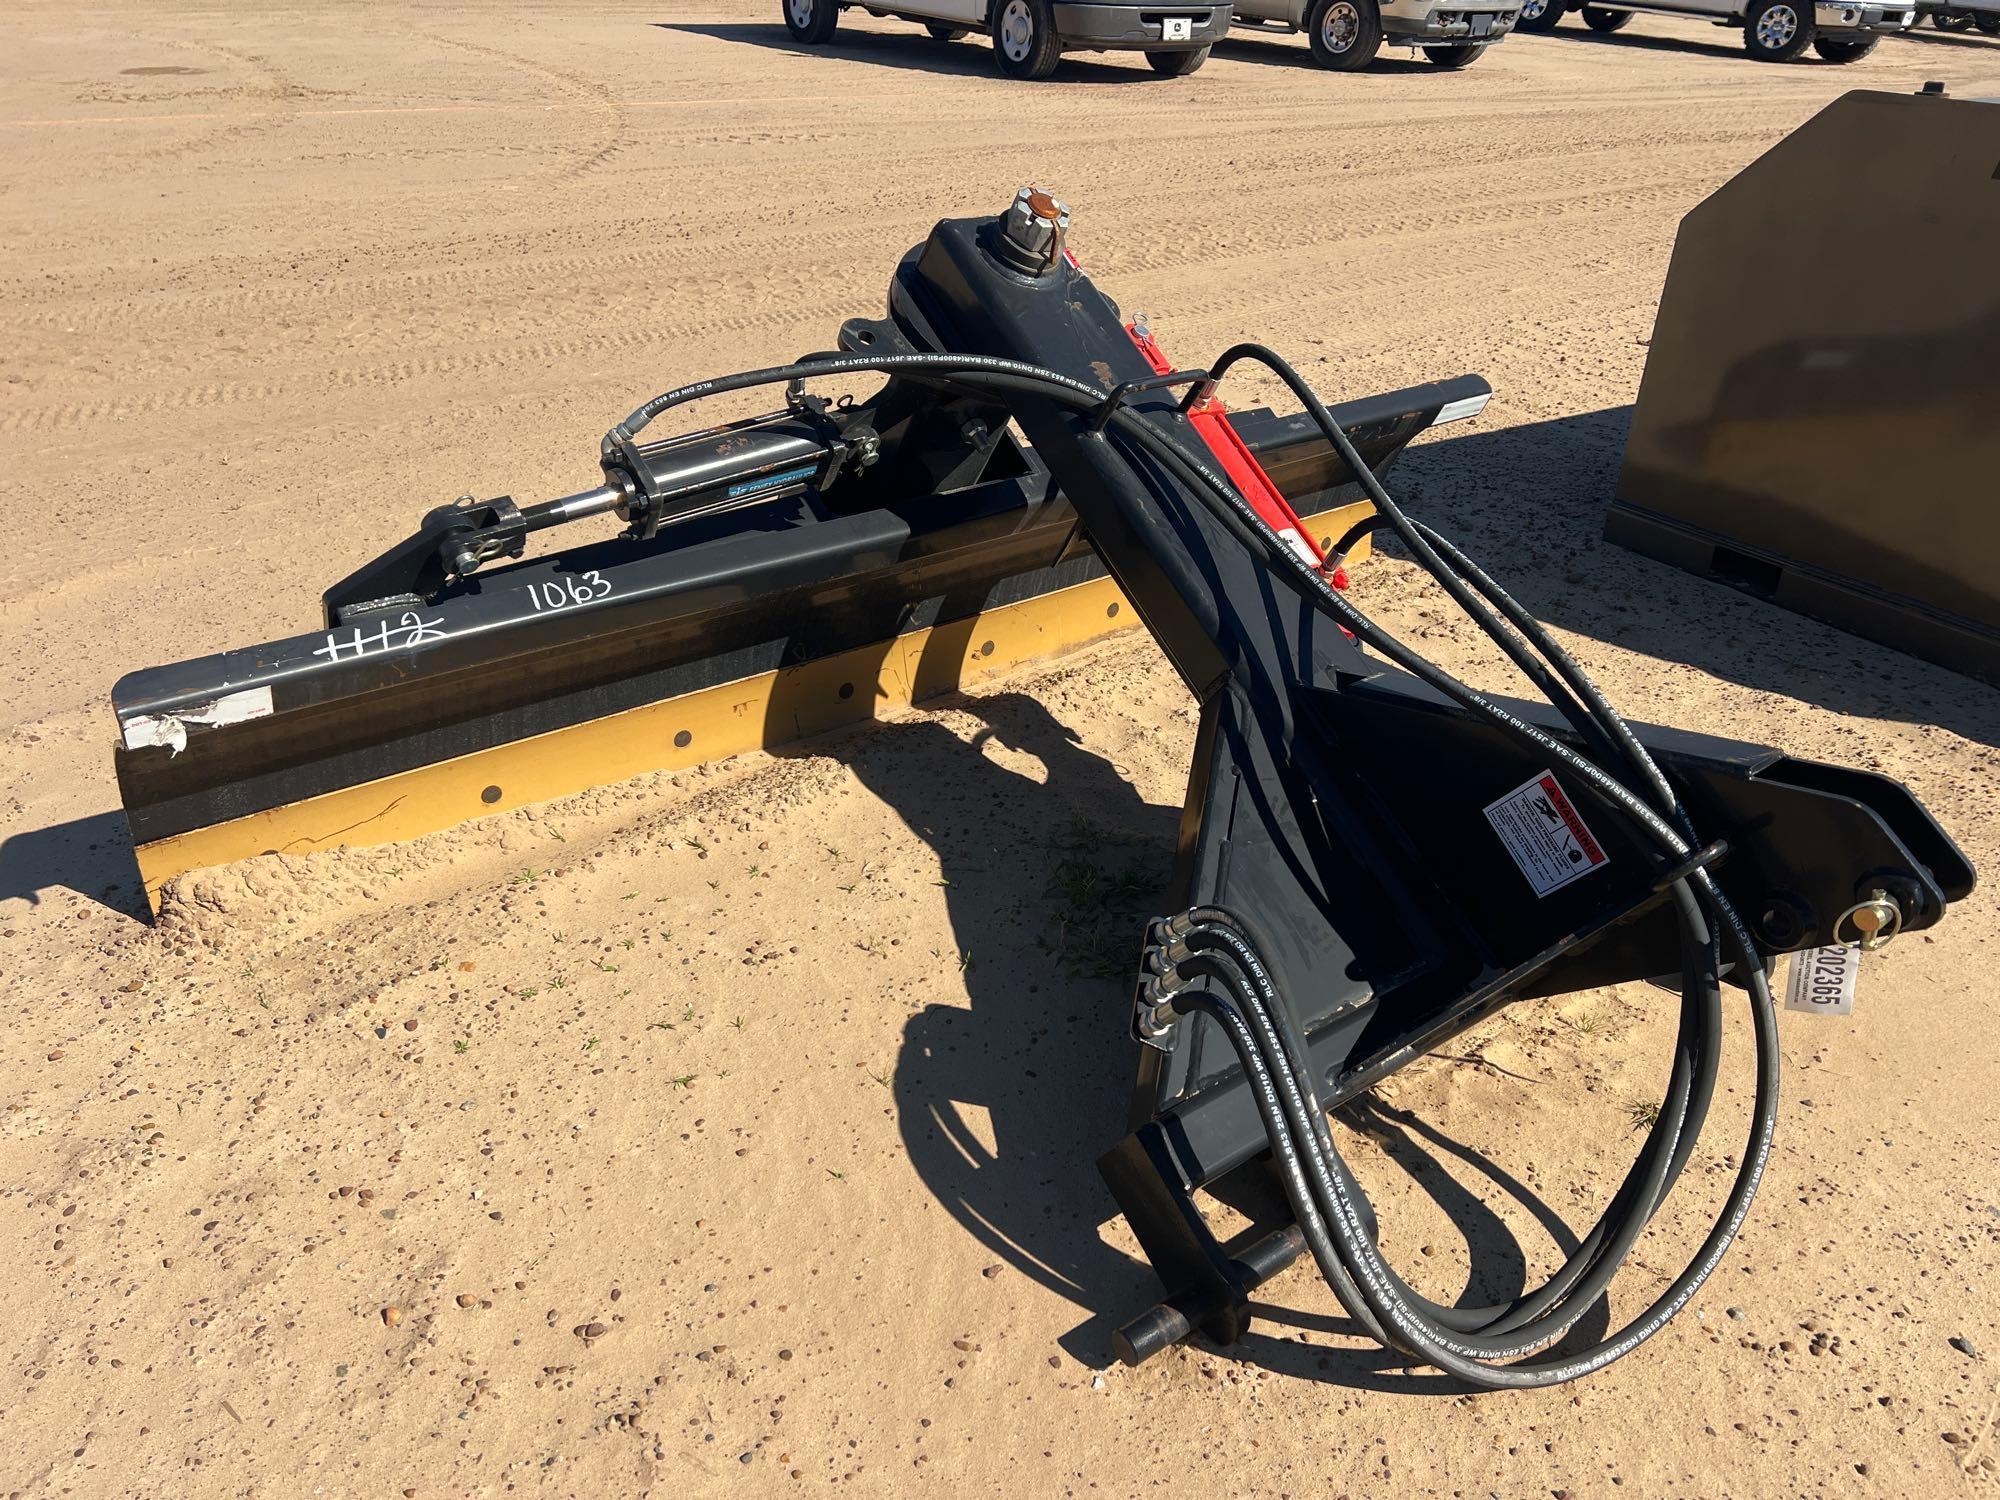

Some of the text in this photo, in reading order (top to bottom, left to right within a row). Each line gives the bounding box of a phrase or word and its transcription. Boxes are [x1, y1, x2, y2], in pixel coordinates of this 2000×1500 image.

[848, 357, 869, 366] R2AT
[886, 355, 905, 363] J517
[1013, 362, 1033, 373] DN10
[1034, 368, 1049, 378] 2SN
[1050, 372, 1064, 382] 853
[1065, 377, 1076, 386] EN
[681, 386, 695, 395] DIN
[696, 382, 712, 390] RLC
[1076, 382, 1091, 393] DIN
[668, 391, 680, 399] EN
[1092, 389, 1108, 400] RLC
[527, 571, 611, 610] 1063
[1486, 704, 1510, 720] R2AT
[1510, 717, 1526, 729] 100
[1526, 728, 1549, 742] J517
[1635, 803, 1652, 819] 330
[1554, 797, 1597, 857] WARNING
[1652, 816, 1668, 834] WP
[1718, 896, 1731, 910] EN
[1740, 931, 1754, 954] RLC
[1243, 951, 1255, 963] EN
[1250, 962, 1264, 978] DIN
[1804, 961, 1812, 980] AUCTION
[1811, 947, 1848, 1004] 202365
[1259, 978, 1274, 998] RLC
[1244, 1035, 1256, 1052] 330
[1251, 1054, 1264, 1072] WP
[1260, 1073, 1275, 1102] DN10
[1271, 1105, 1285, 1130] 2SN
[1280, 1132, 1293, 1155] 853
[1240, 980, 1255, 996] RLC
[1251, 997, 1264, 1014] DIN
[1260, 1015, 1271, 1030] EN
[1267, 1031, 1280, 1050] 853
[1276, 1052, 1290, 1075] 2SN
[1286, 1077, 1302, 1108] DN10
[1298, 1109, 1310, 1130] WP
[1307, 1132, 1319, 1154] 330
[1391, 1309, 1414, 1334] R2AT
[1306, 1203, 1320, 1228] RLC
[1340, 1196, 1359, 1227] R2AT
[1355, 1228, 1369, 1248] 100
[1365, 1251, 1382, 1273] J517
[1556, 1368, 1574, 1380] RLC
[1576, 1362, 1591, 1373] DIN
[1621, 1336, 1639, 1352] 2SN
[1638, 1319, 1660, 1340] DN10
[1660, 1307, 1673, 1321] WP
[1673, 1293, 1688, 1309] 330
[1742, 1186, 1755, 1209] J517
[1752, 1166, 1763, 1183] 100
[1758, 1138, 1770, 1167] R2AT
[1447, 1341, 1463, 1353] 330
[1536, 1336, 1548, 1347] EN
[1463, 1349, 1477, 1357] WP
[1478, 1350, 1501, 1358] DN10
